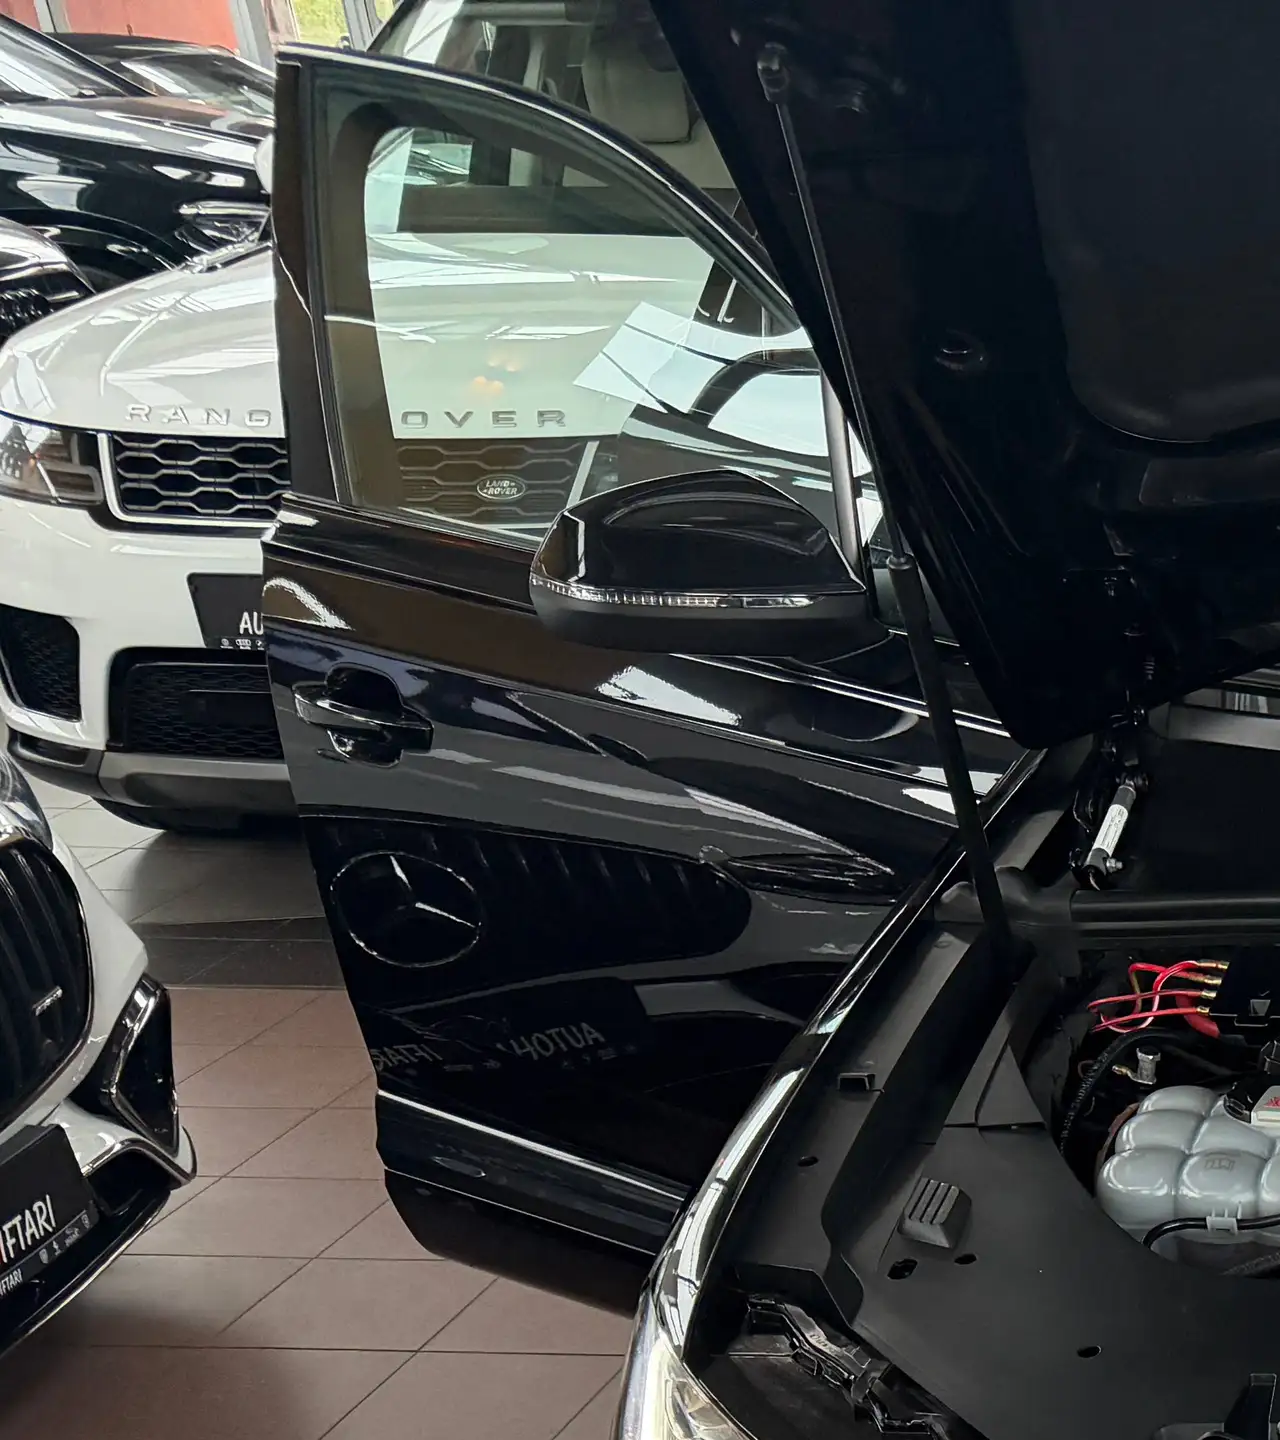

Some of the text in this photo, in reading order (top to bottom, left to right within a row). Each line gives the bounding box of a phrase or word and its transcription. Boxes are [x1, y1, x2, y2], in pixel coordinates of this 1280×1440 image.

[124, 403, 567, 430] RANG OVER
[485, 480, 510, 488] LAND
[487, 487, 518, 495] ROVER
[0, 1194, 57, 1264] IFTARI
